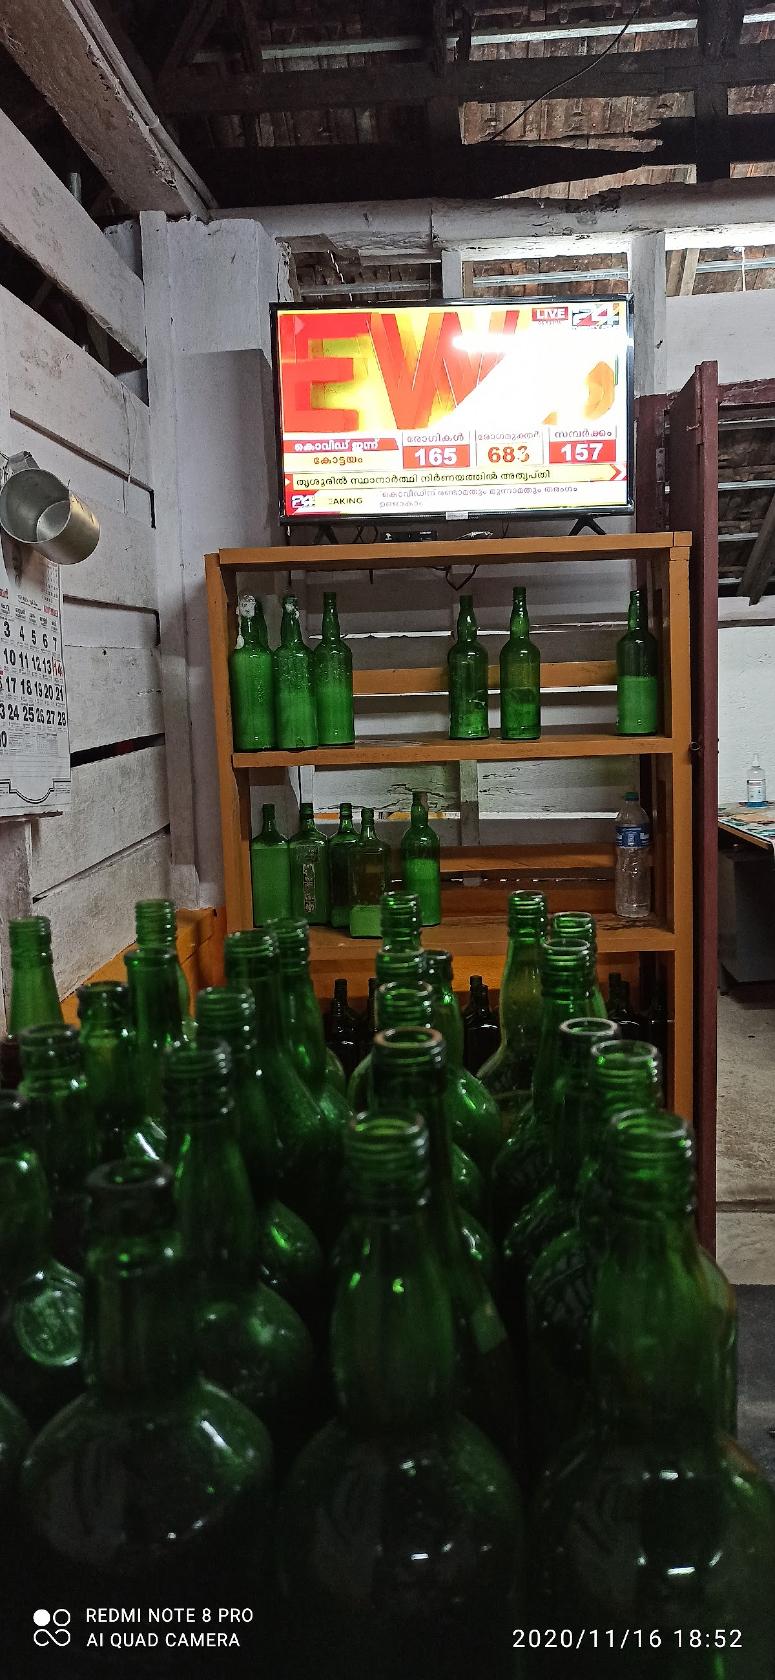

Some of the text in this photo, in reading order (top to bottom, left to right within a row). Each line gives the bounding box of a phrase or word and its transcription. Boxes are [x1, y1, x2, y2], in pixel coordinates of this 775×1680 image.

[536, 308, 566, 320] LIVE
[294, 439, 351, 452] കൊവിഡ്
[407, 432, 464, 442] രോഗികൾ
[415, 447, 457, 466] 165
[488, 445, 530, 463] 683
[561, 442, 603, 461] 157
[313, 456, 363, 466] കോട്ടയം
[4, 621, 57, 651] 3 4 5 6 7
[4, 648, 16, 665] 10
[19, 651, 29, 668] 11
[32, 655, 41, 671] 12
[43, 658, 51, 674] 13
[6, 676, 16, 693] 17
[21, 679, 32, 695] 18
[35, 681, 42, 697] 19
[44, 684, 53, 700] 20
[56, 685, 63, 701] 21
[0, 703, 66, 726] 3 24 25 26 27 28
[0, 731, 7, 747] 0
